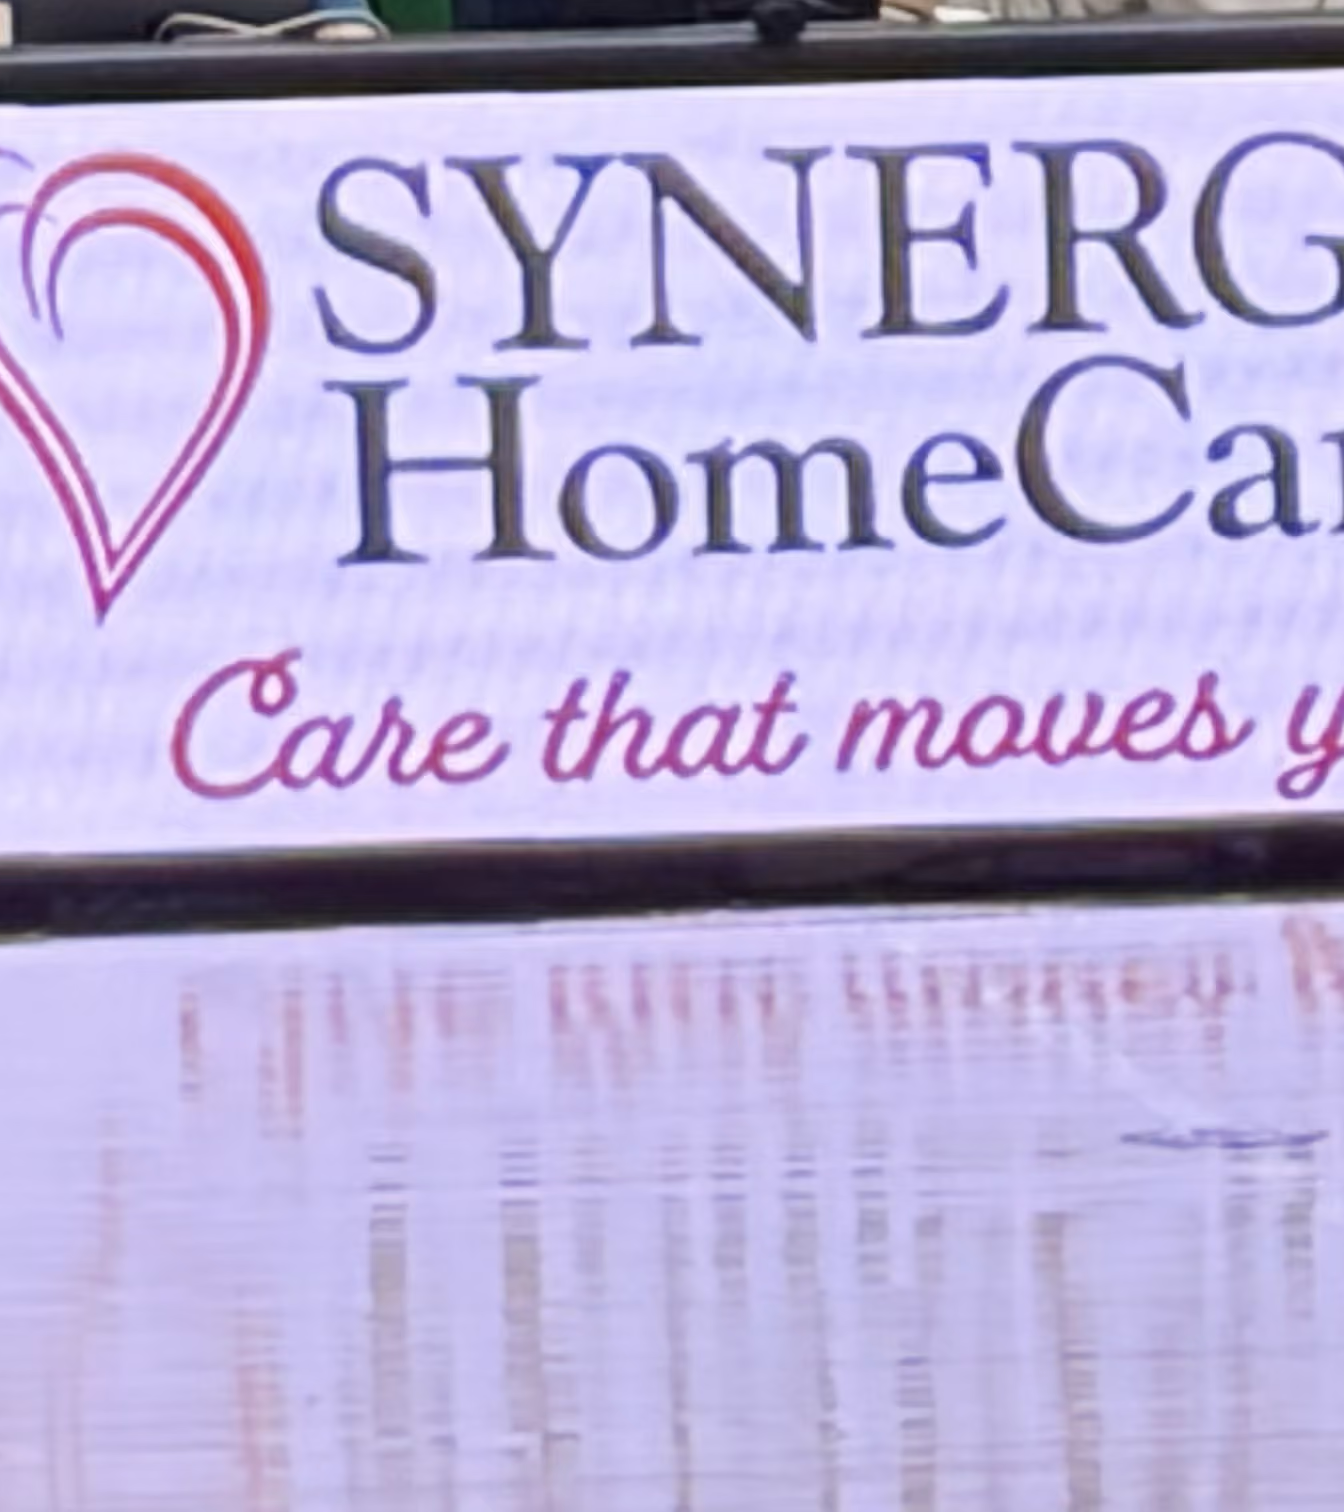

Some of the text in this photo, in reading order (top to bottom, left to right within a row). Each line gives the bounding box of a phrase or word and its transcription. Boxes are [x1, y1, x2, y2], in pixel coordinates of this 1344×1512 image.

[170, 646, 510, 801] Care
[540, 668, 810, 782] that
[836, 669, 1256, 775] moves
